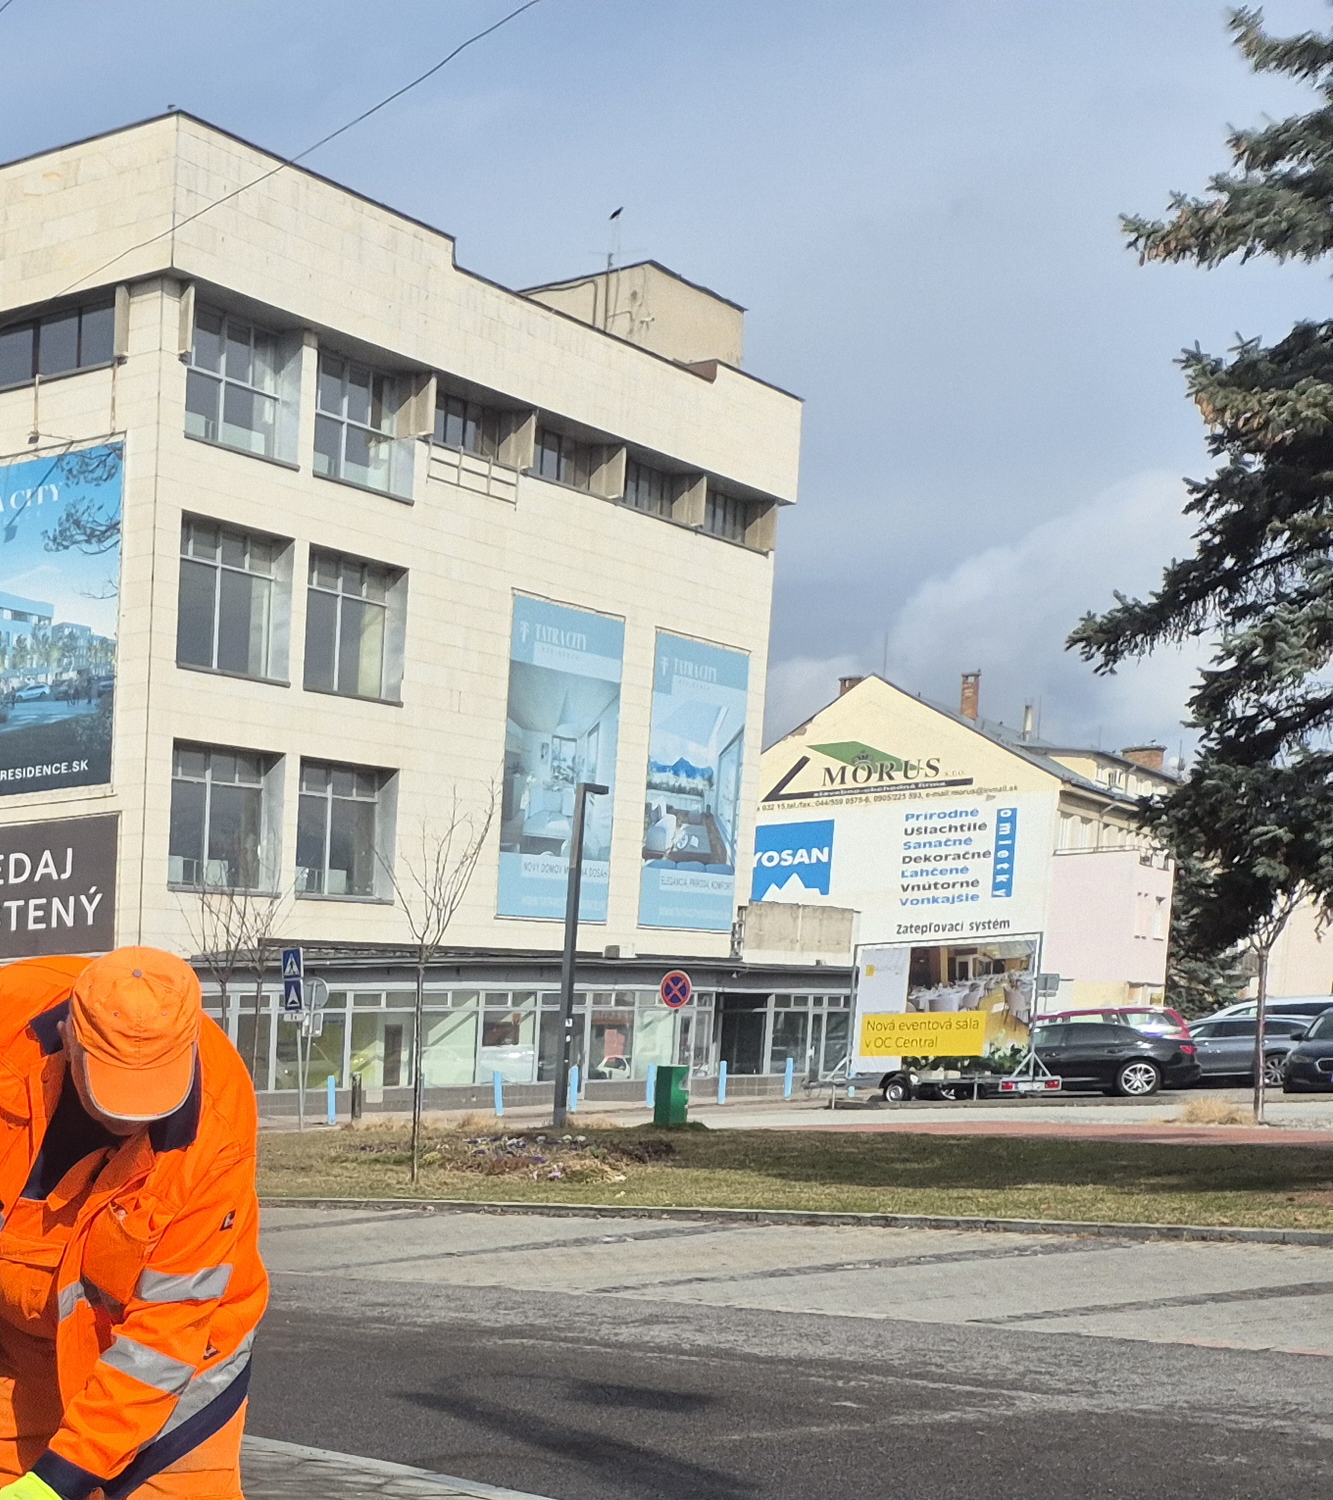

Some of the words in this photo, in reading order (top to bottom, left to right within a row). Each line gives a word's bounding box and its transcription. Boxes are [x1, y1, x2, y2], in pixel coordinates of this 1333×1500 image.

[821, 757, 941, 787] MORUS
[968, 918, 1011, 933] systém
[866, 1017, 895, 1032] Nová
[898, 1016, 953, 1031] eventová
[955, 1017, 979, 1030] sála
[873, 1036, 892, 1048] OC
[895, 1036, 938, 1048] Central
